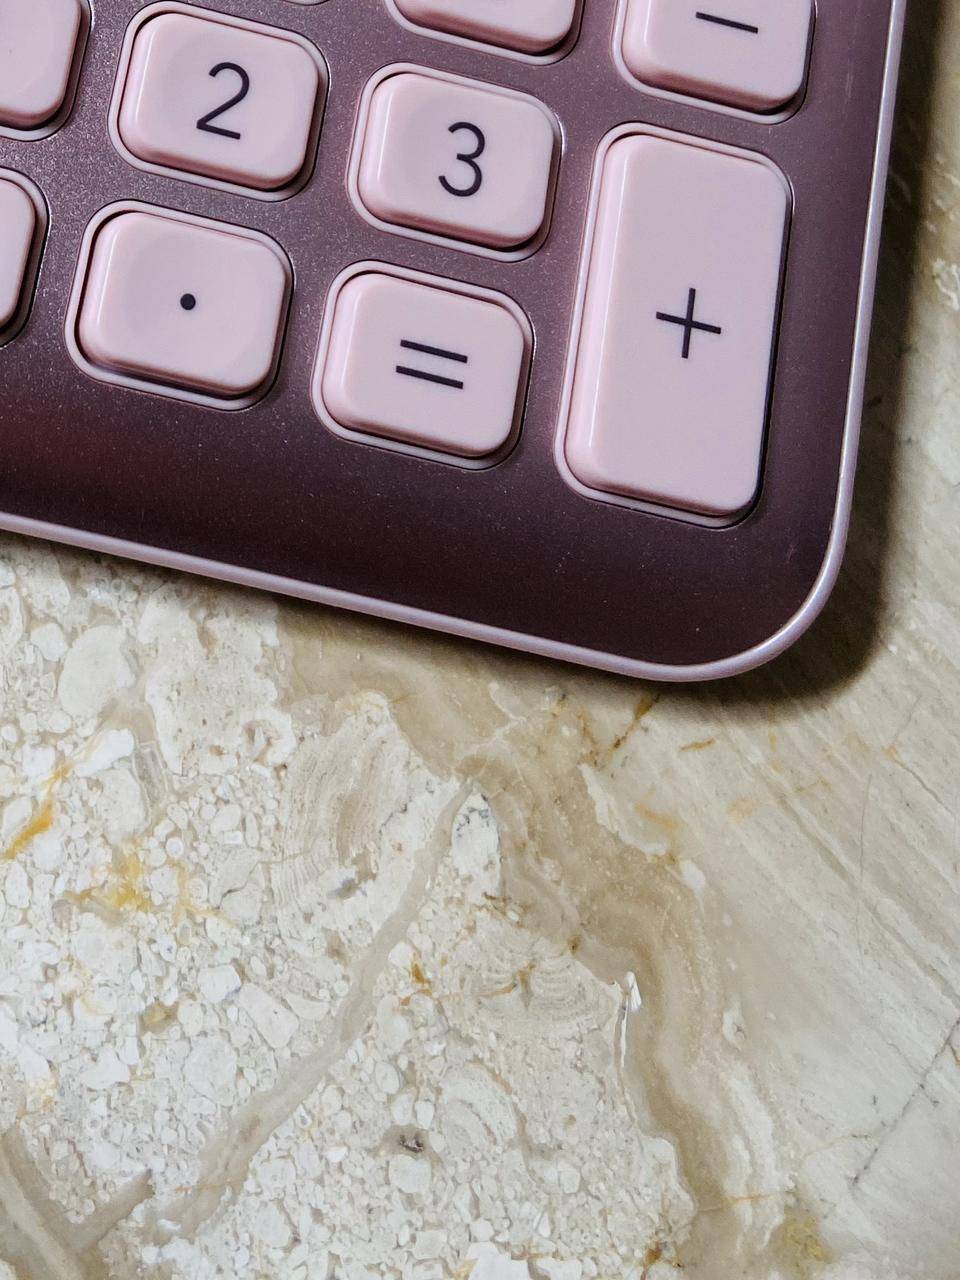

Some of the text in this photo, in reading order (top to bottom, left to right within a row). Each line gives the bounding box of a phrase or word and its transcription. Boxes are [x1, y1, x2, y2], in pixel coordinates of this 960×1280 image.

[195, 61, 250, 140] 2
[438, 121, 486, 198] 3
[655, 287, 722, 360] +
[395, 339, 469, 390] =
